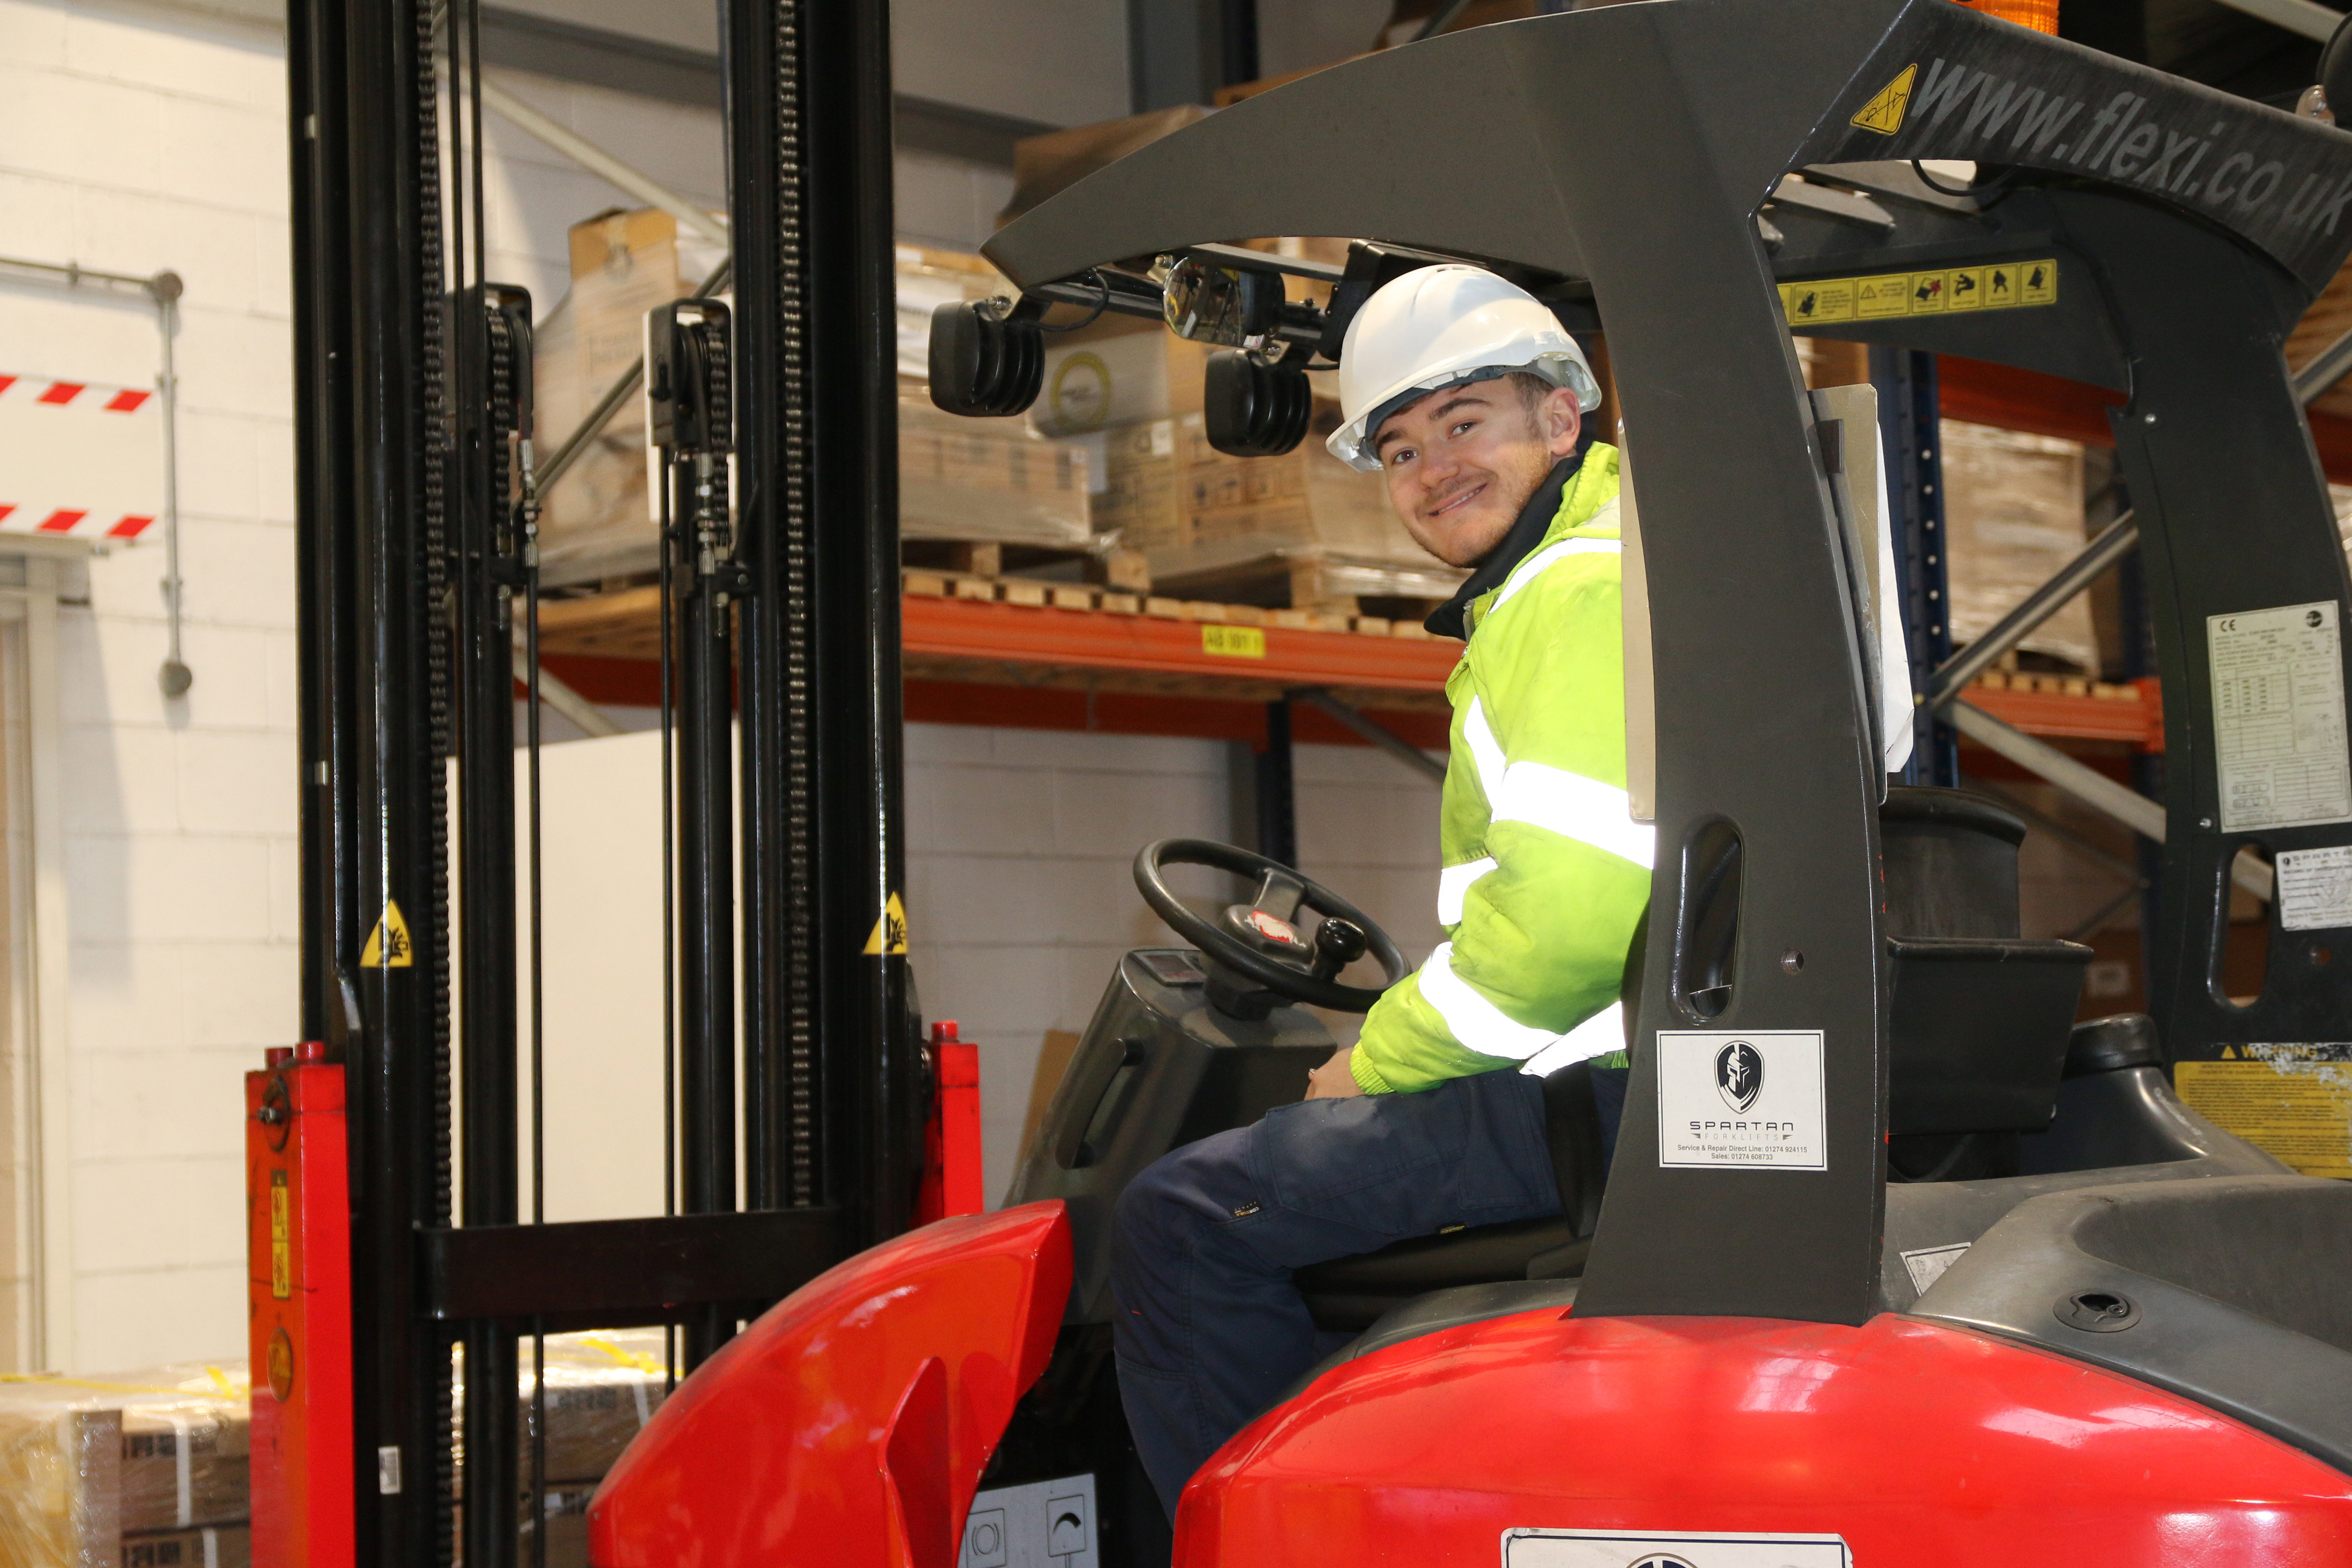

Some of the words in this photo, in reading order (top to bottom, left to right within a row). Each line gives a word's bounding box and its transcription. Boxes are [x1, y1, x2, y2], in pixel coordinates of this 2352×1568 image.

[1910, 57, 2352, 236] www.flexi.couk
[2241, 1045, 2318, 1059] WING
[1690, 1121, 1794, 1131] SPARTAN
[1707, 1145, 1727, 1153] Repair
